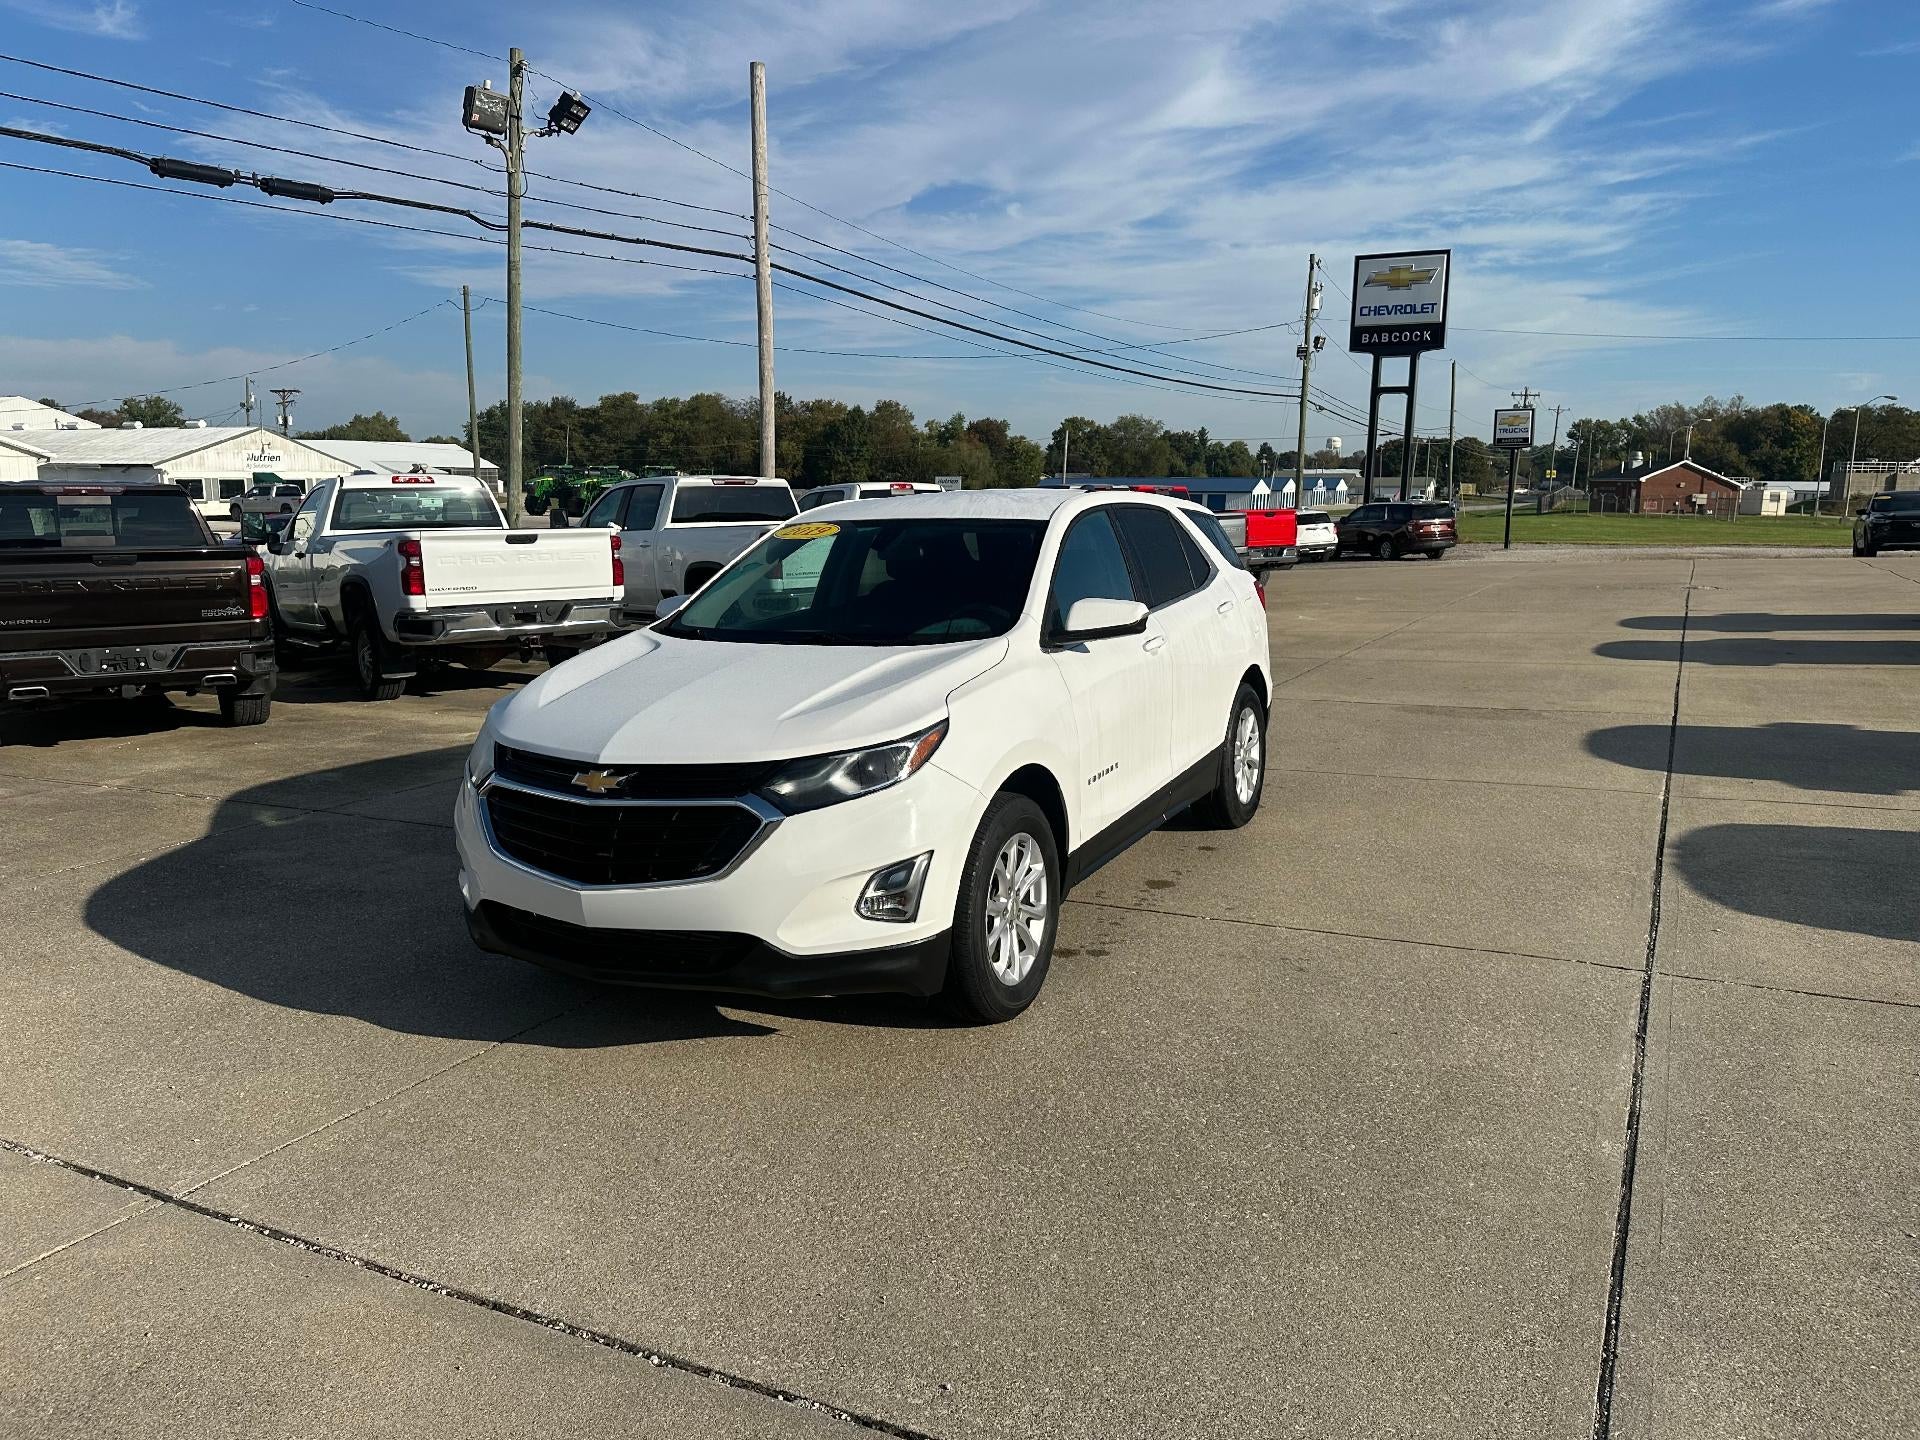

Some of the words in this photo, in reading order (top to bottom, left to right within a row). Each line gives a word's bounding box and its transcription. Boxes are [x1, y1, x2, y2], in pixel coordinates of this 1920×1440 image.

[1359, 302, 1437, 317] CHEVROLET
[1361, 330, 1431, 343] BABCOCK
[246, 453, 281, 461] Nutrien
[782, 526, 832, 536] 2019
[438, 551, 600, 567] CHEVROLET
